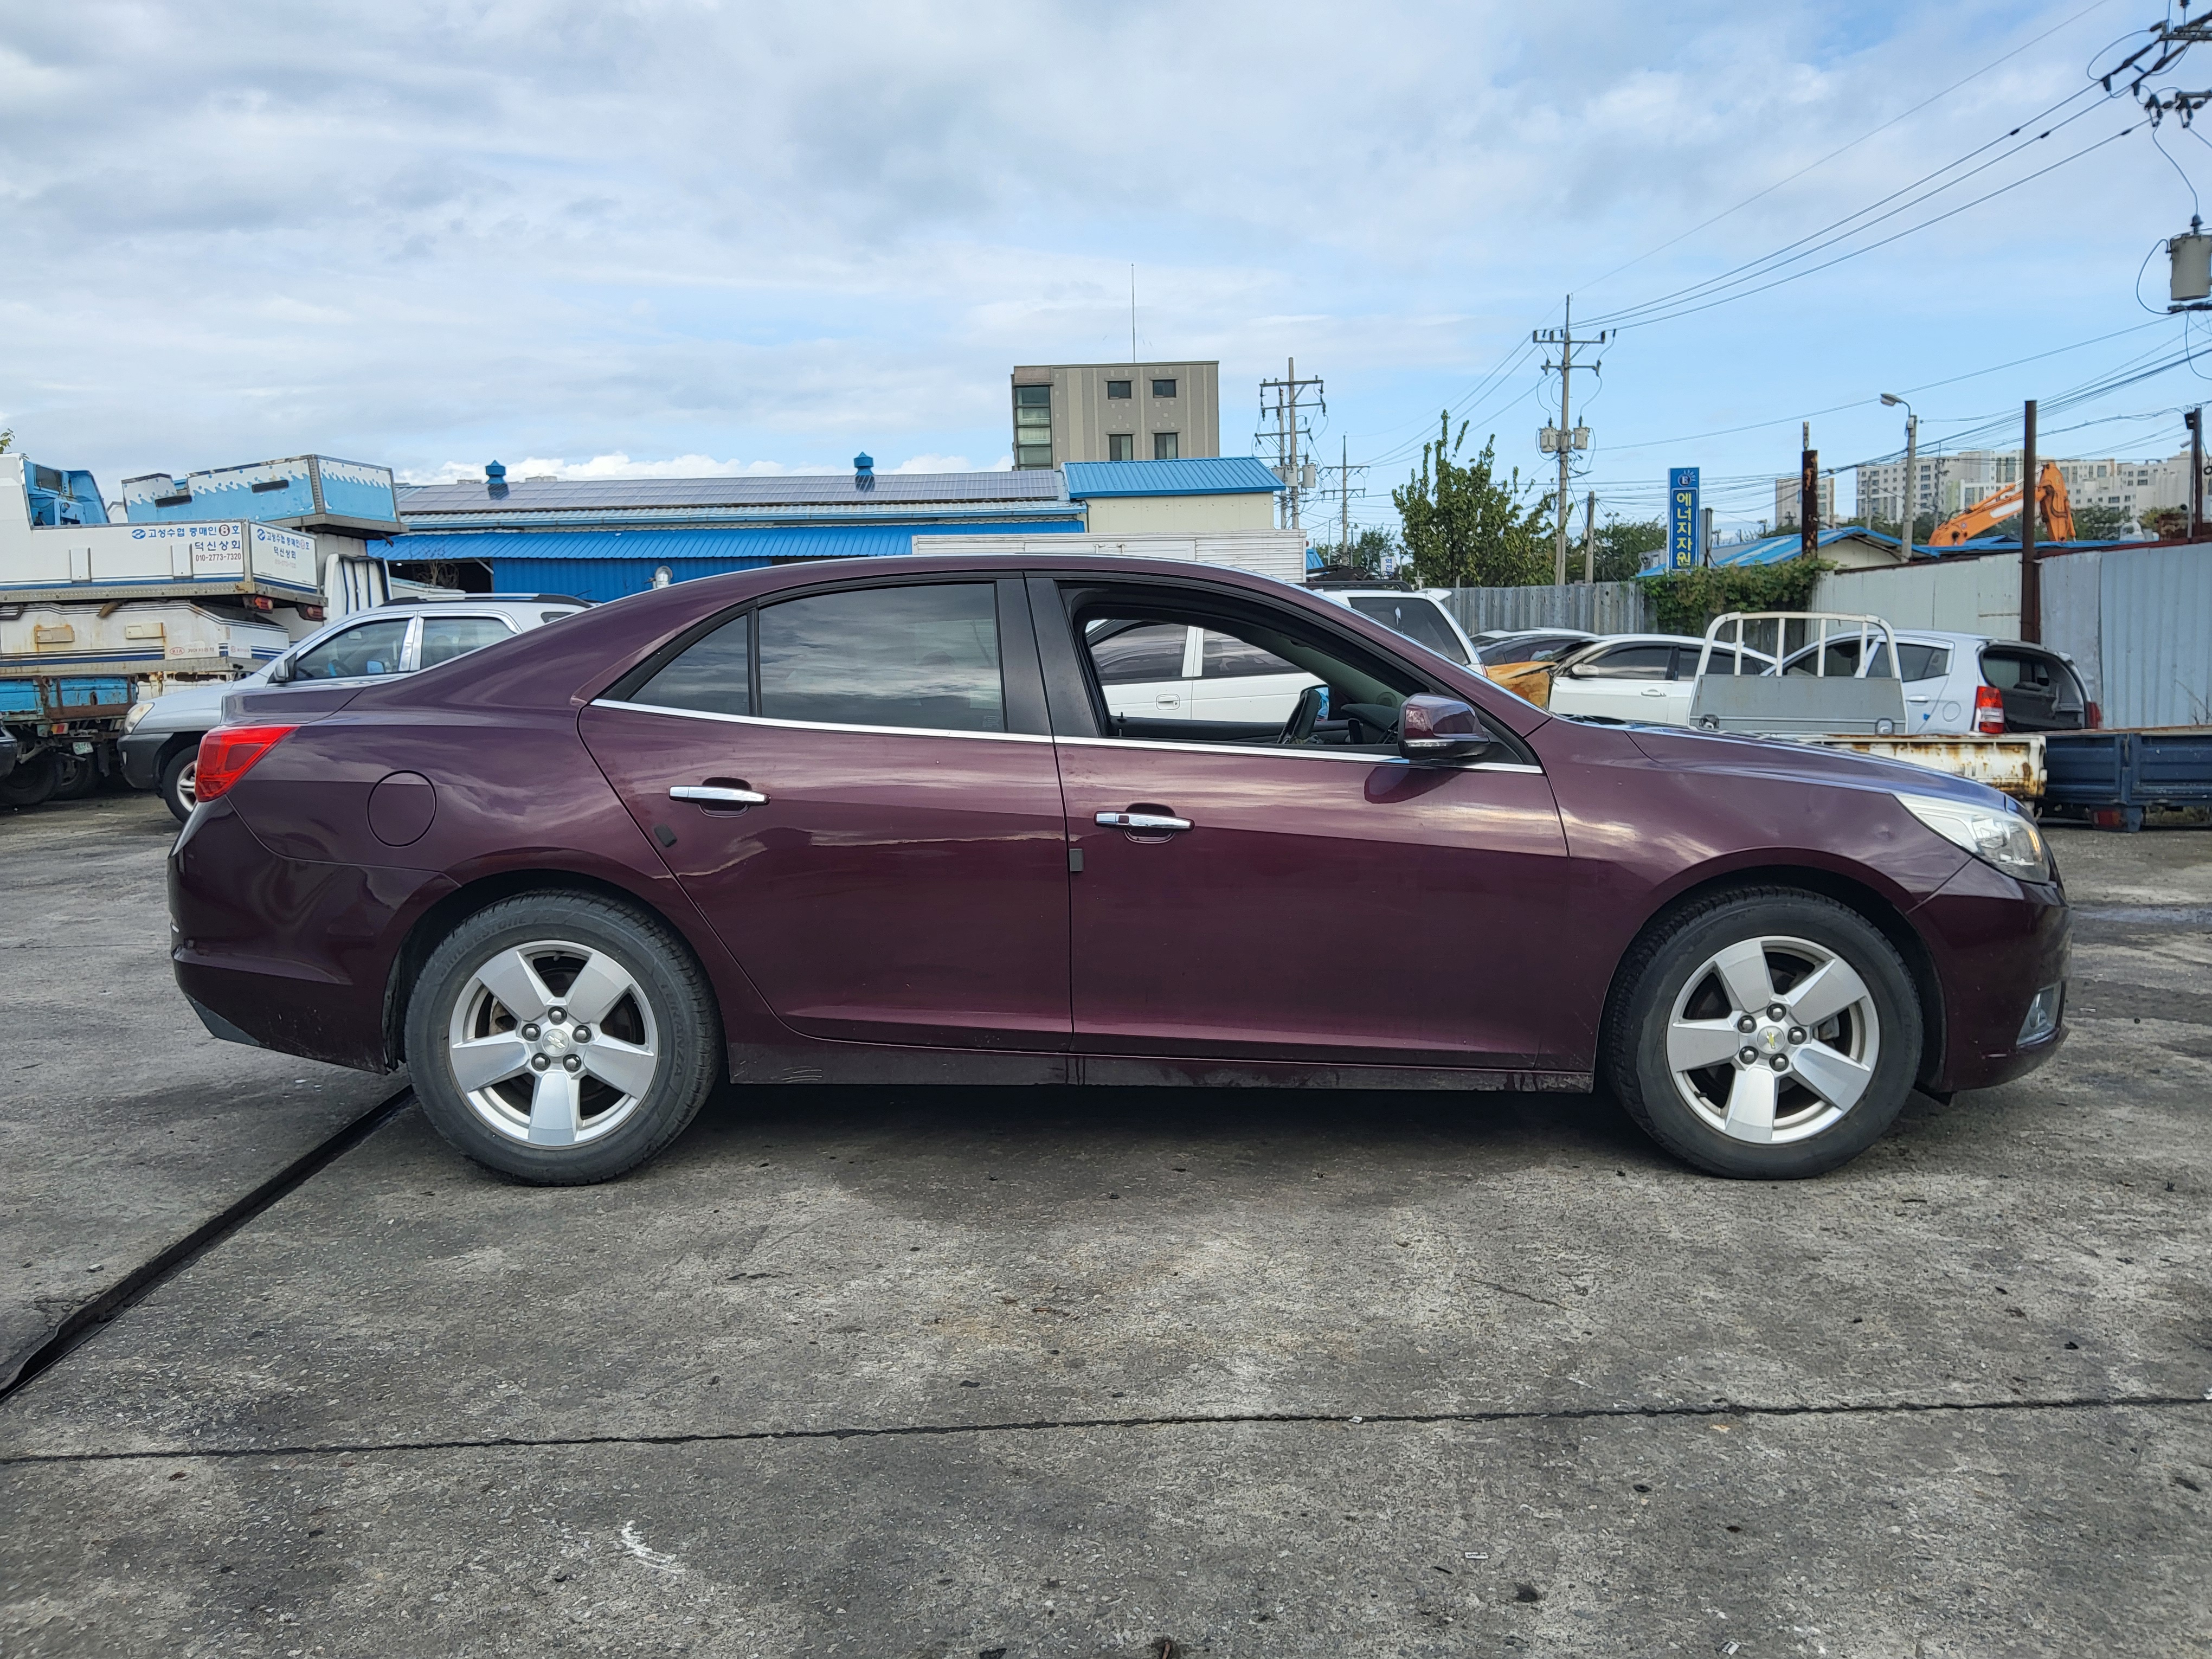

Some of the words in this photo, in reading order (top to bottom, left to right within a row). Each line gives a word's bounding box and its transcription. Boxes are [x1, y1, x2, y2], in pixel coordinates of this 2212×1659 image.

[148, 528, 185, 538] 고성수협
[1676, 492, 1693, 567] 에너지자원
[195, 540, 241, 551] 덕신상회
[195, 552, 241, 562] 010-2773-7320
